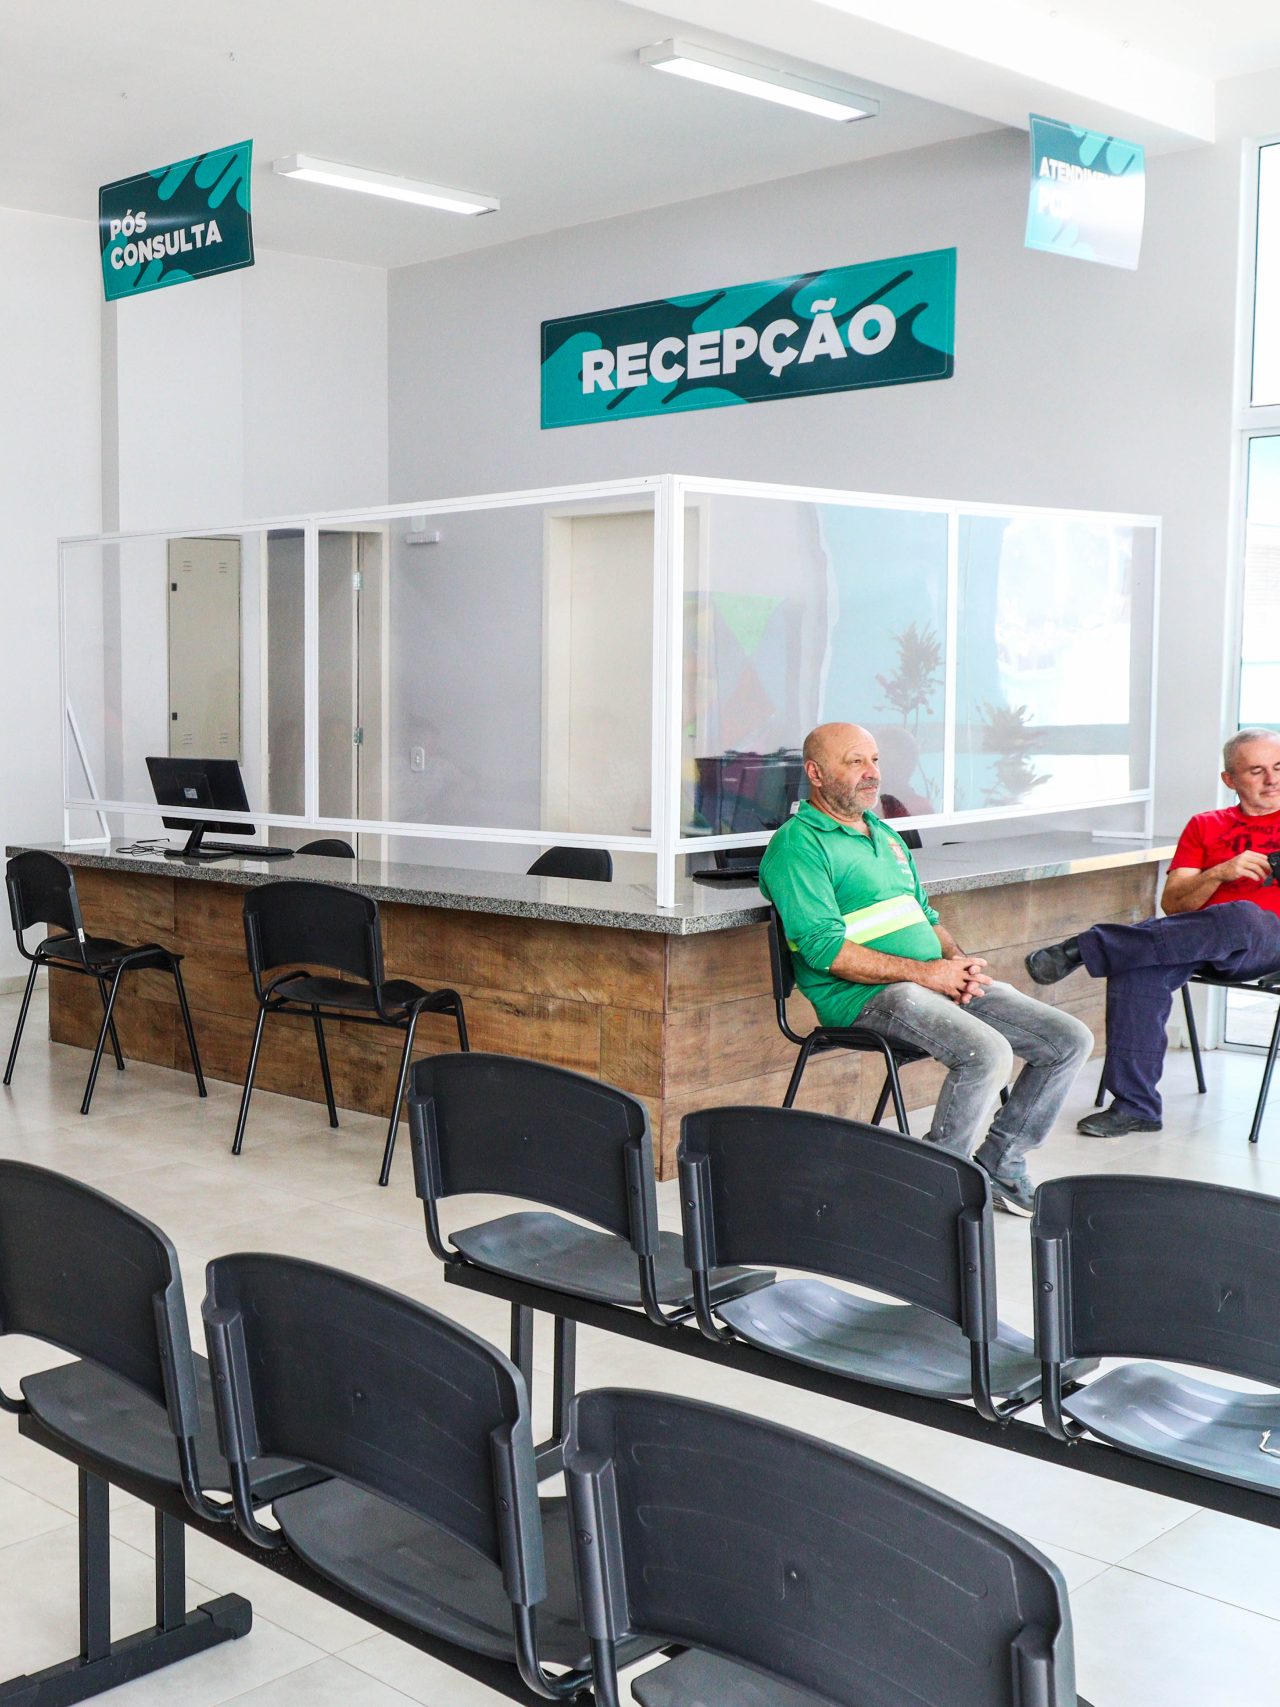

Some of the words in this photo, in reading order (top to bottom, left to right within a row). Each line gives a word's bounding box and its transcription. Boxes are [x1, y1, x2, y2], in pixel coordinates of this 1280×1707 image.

[110, 208, 148, 241] PÓS
[110, 219, 223, 270] CONSULTA
[582, 297, 897, 394] RECEPÇÃO
